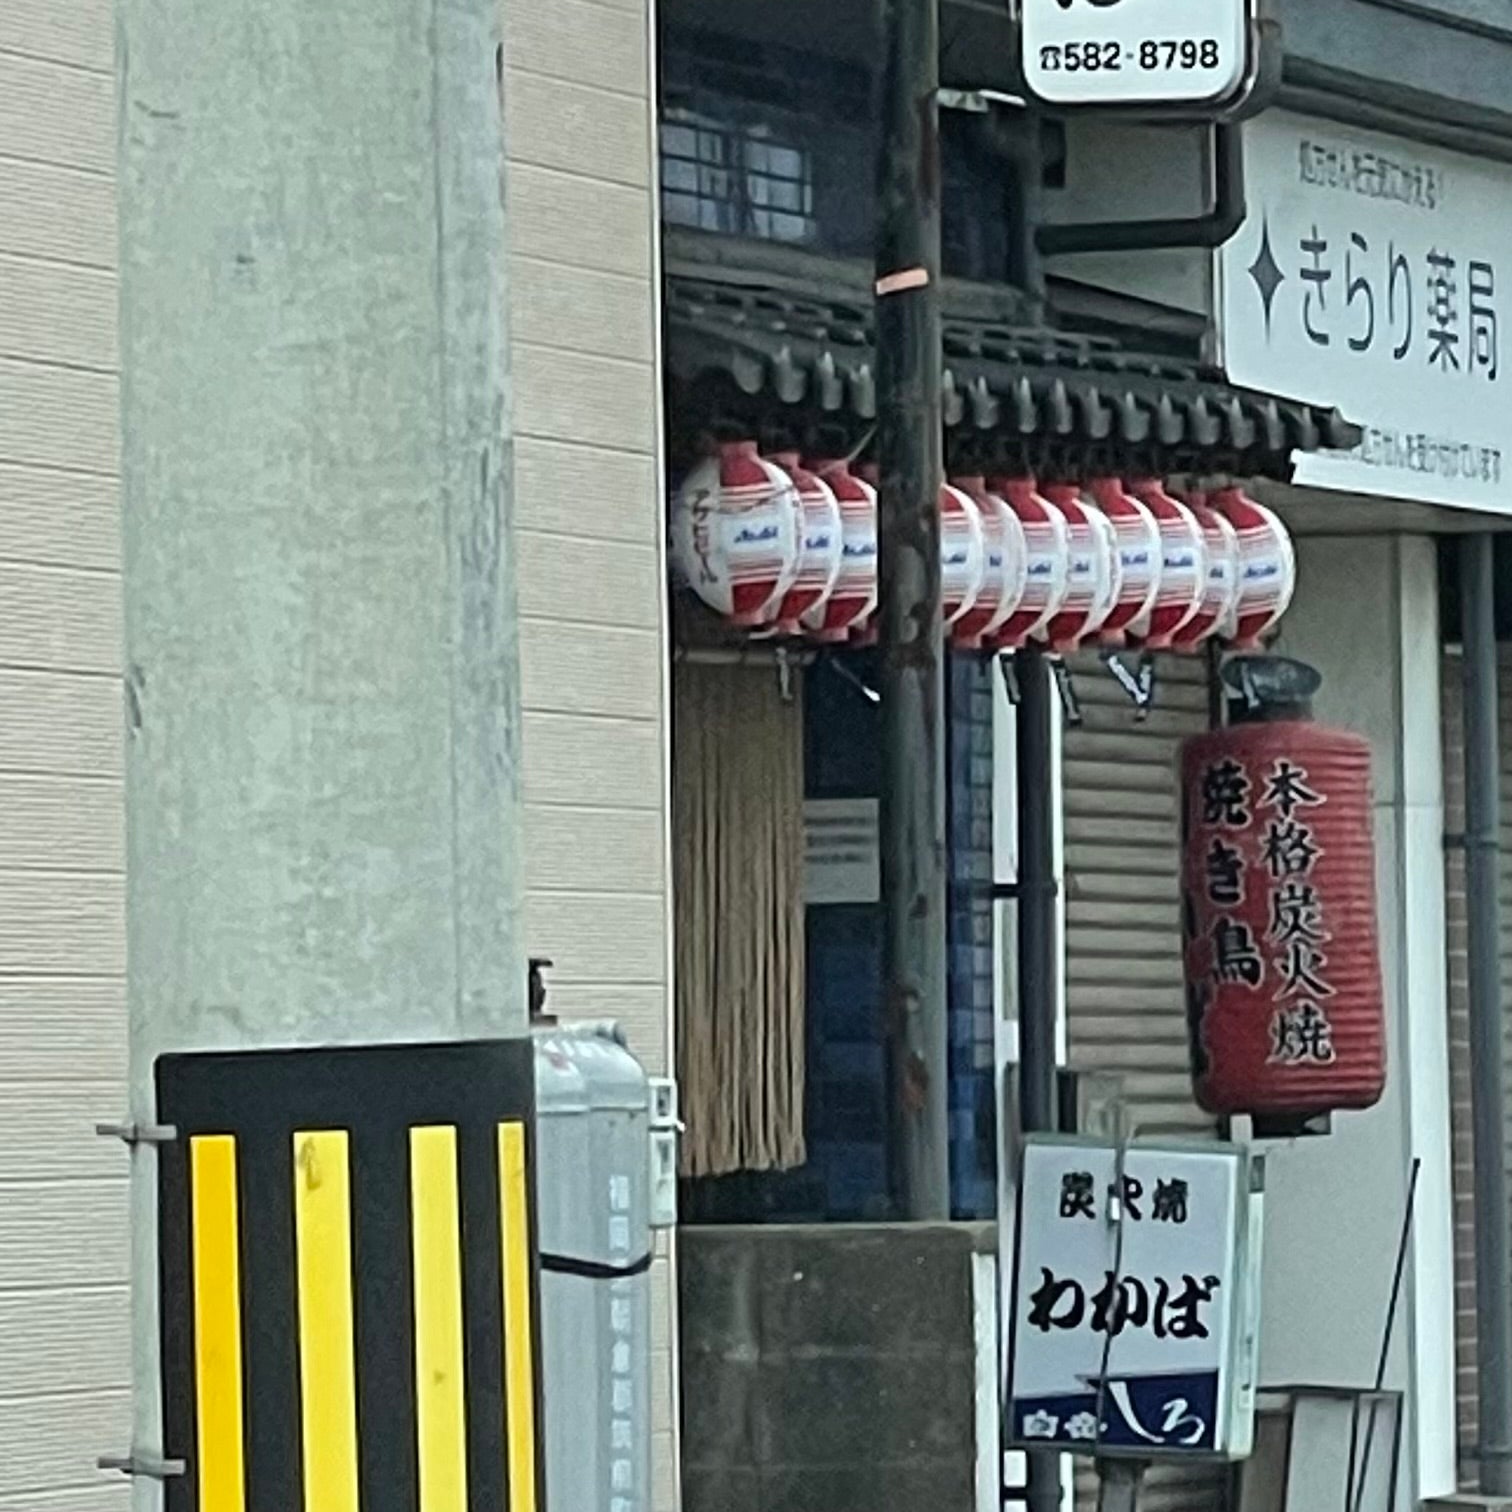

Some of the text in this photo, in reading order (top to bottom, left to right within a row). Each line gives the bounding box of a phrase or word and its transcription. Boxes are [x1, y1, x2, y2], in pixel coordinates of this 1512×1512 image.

[1299, 224, 1499, 381] きらり薬局
[1202, 761, 1262, 987] 焼き鳥
[1260, 761, 1336, 1064] 本格炭火焼
[1028, 1267, 1221, 1338] わかば
